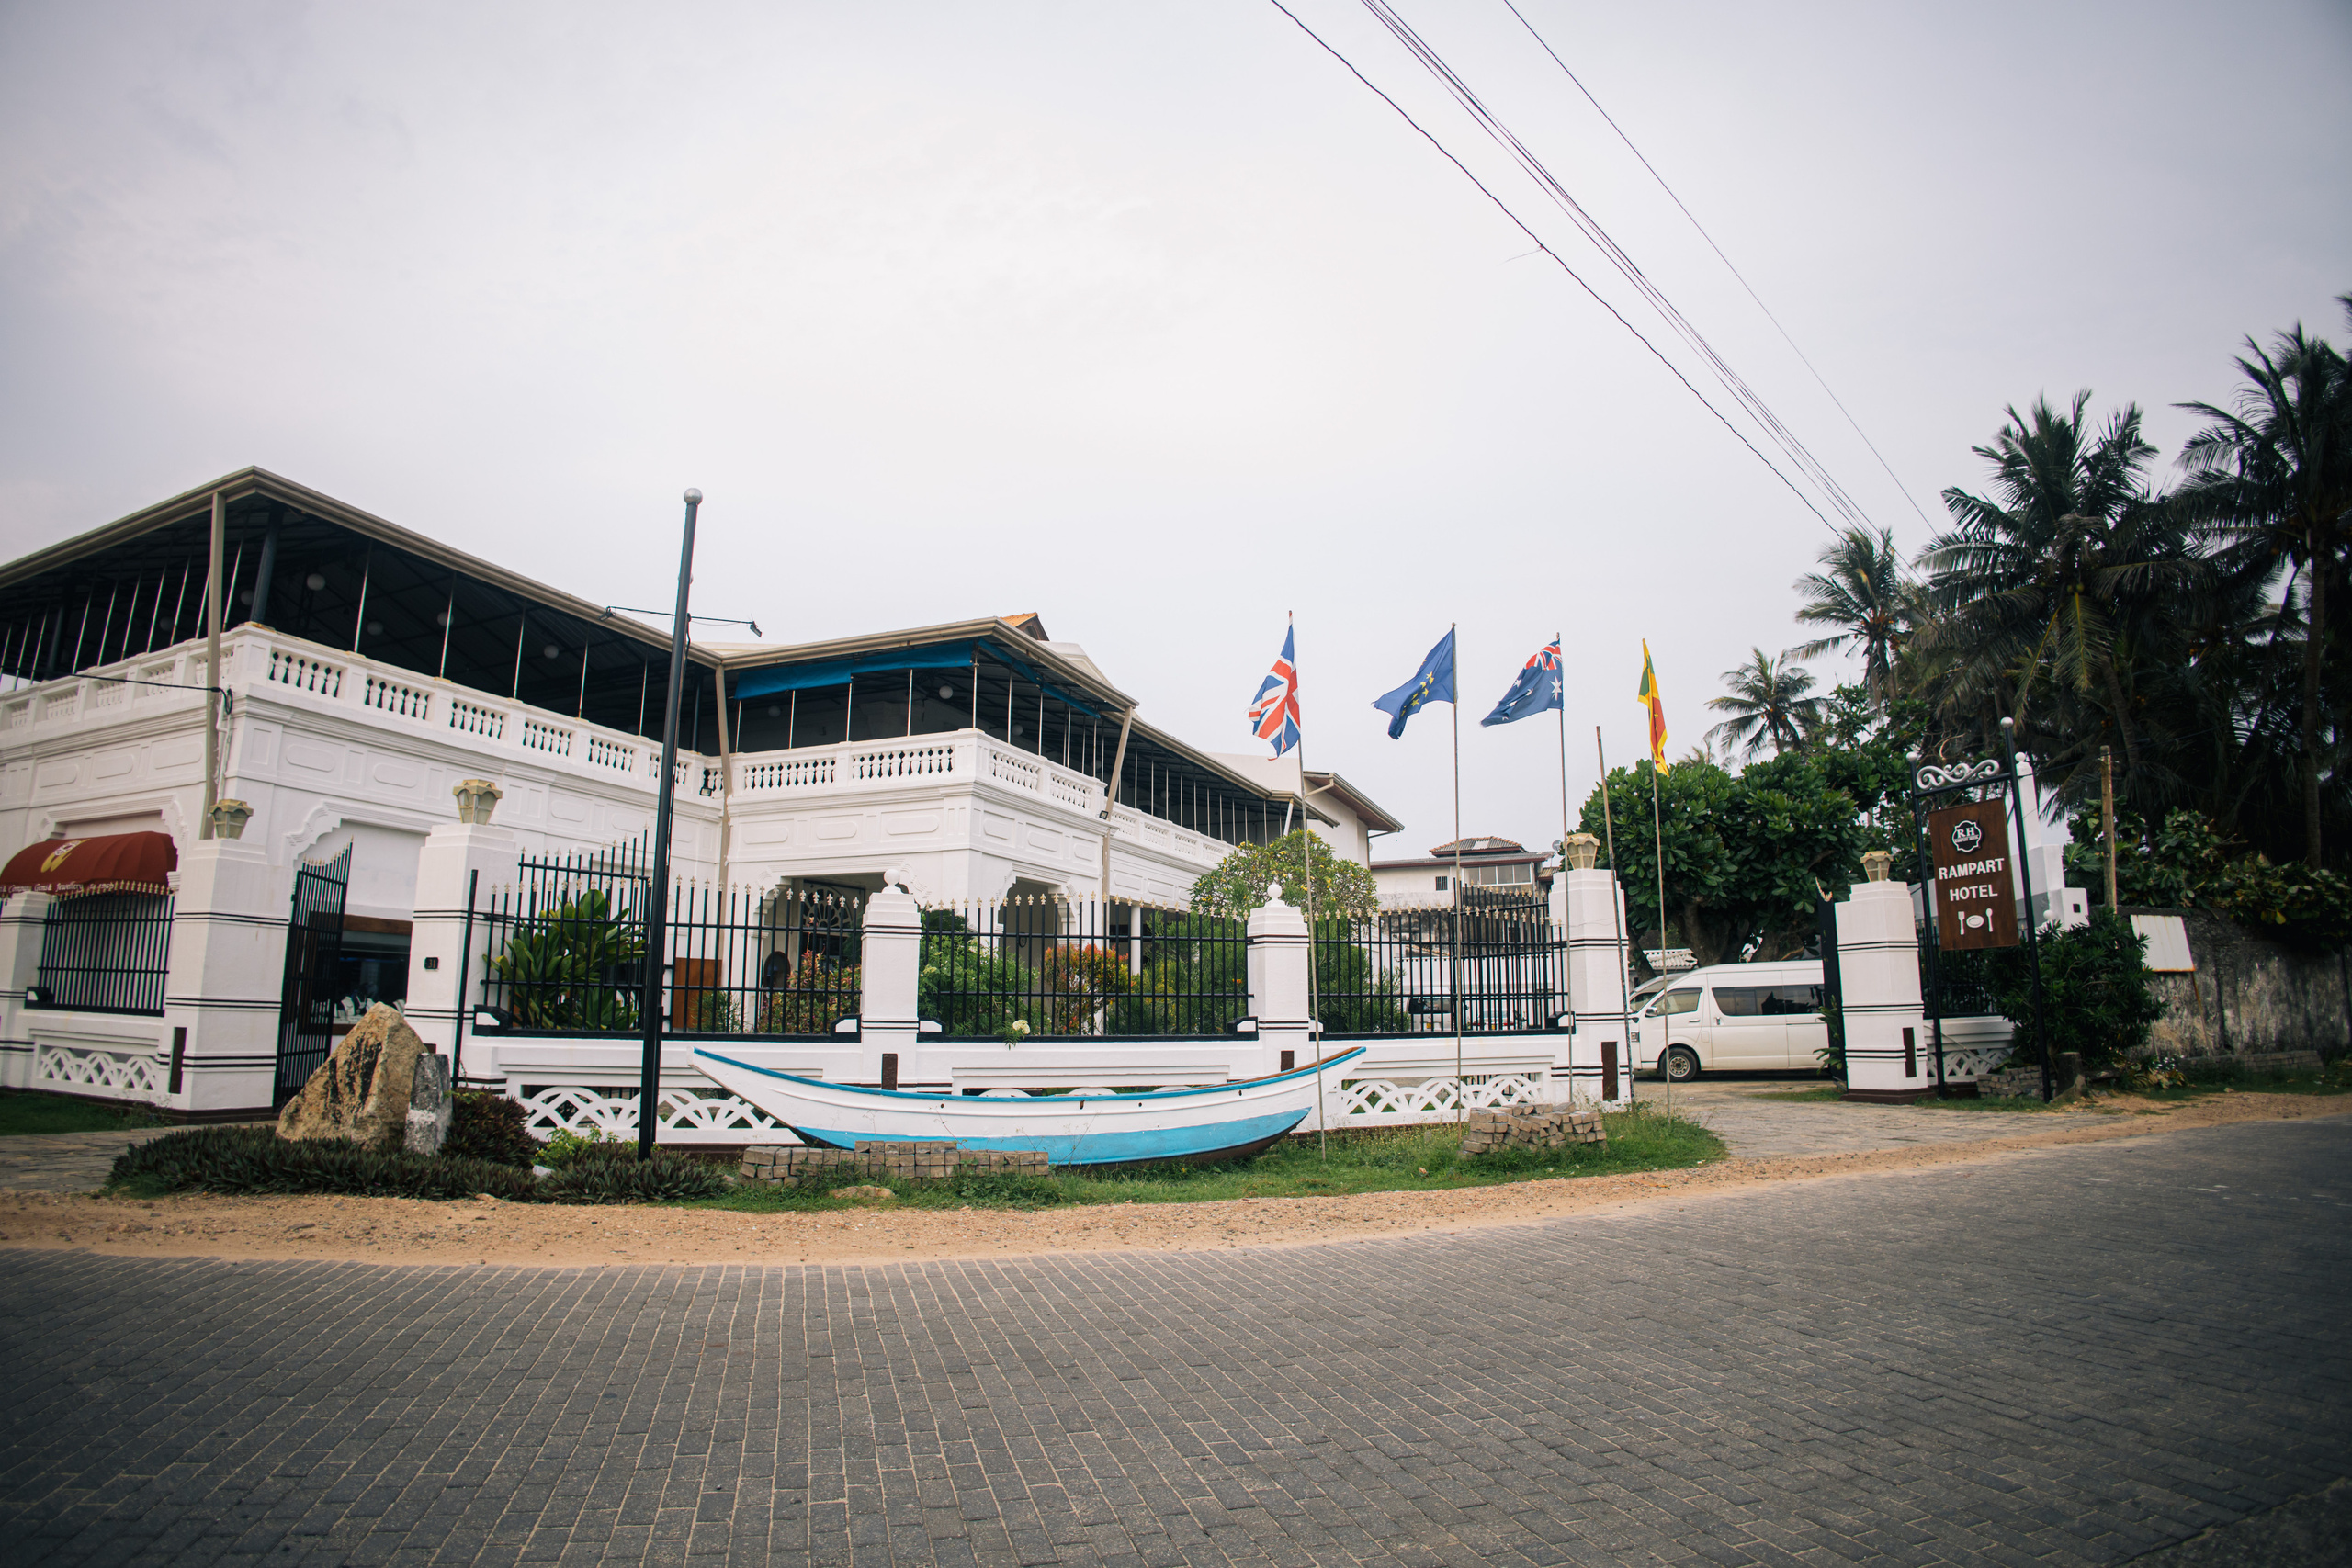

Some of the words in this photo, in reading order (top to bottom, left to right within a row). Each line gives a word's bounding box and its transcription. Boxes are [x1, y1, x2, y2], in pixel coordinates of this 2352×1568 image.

[1956, 827, 1975, 838] RH
[1939, 858, 2005, 880] RAMPART
[1950, 884, 1998, 901] HOTEL
